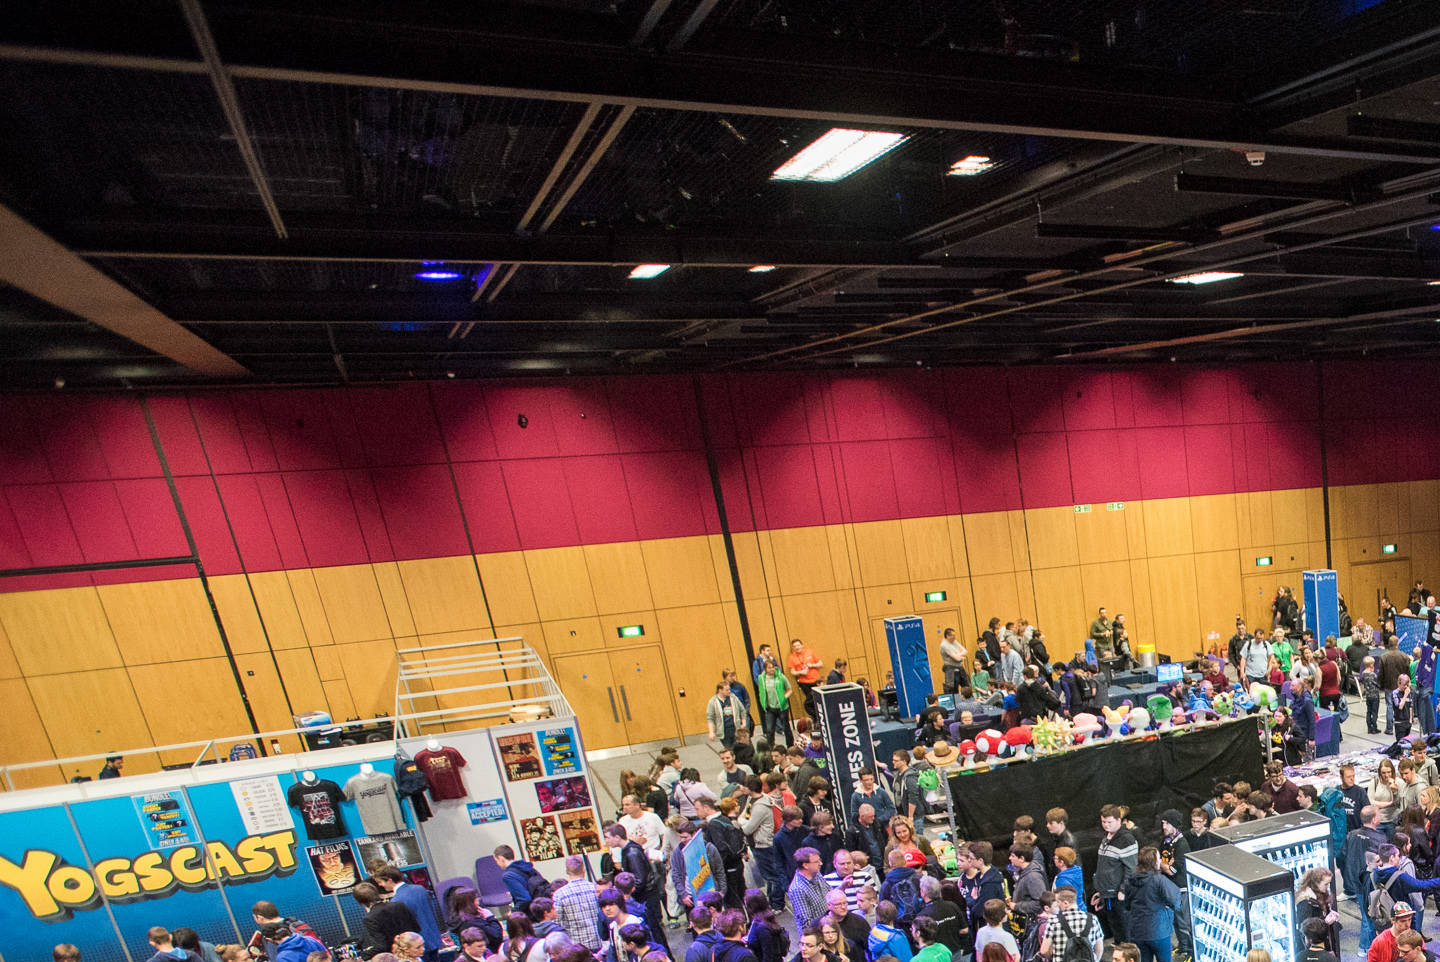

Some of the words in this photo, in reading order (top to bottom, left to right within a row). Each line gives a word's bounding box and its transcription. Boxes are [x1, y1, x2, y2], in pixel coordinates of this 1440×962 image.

[839, 701, 862, 749] ZONE
[310, 845, 324, 856] HAT
[325, 842, 349, 853] FILMS
[0, 829, 297, 918] YOGSCAST
